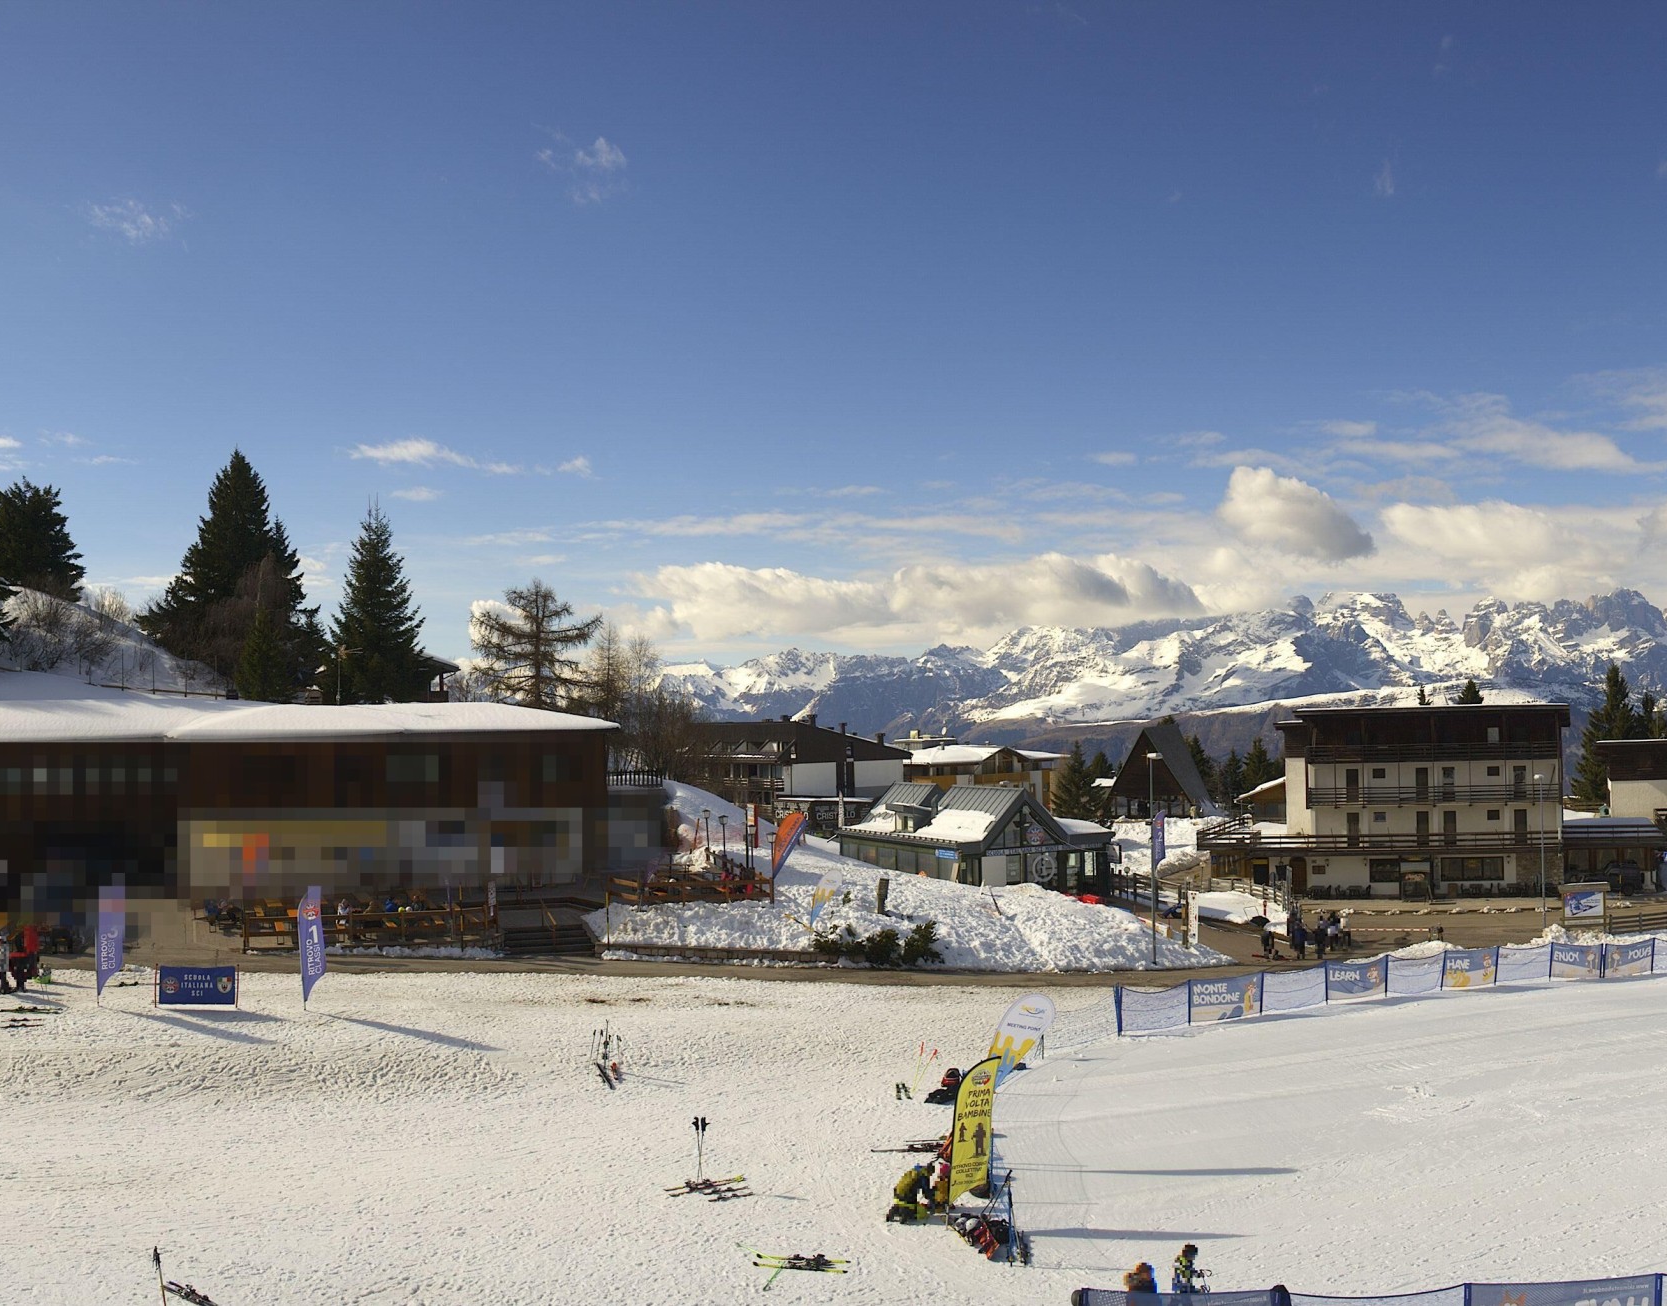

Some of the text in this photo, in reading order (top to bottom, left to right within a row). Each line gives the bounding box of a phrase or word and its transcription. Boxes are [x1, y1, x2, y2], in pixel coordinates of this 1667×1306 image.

[308, 925, 318, 944] 1
[314, 943, 322, 974] CLASSI
[1553, 950, 1580, 962] ENJOY
[1329, 969, 1360, 982] LEARN
[1193, 982, 1228, 996] MONTE
[1193, 991, 1240, 1005] BONDONE
[1007, 1022, 1027, 1030] MEETING
[968, 1088, 991, 1099] PRIMA
